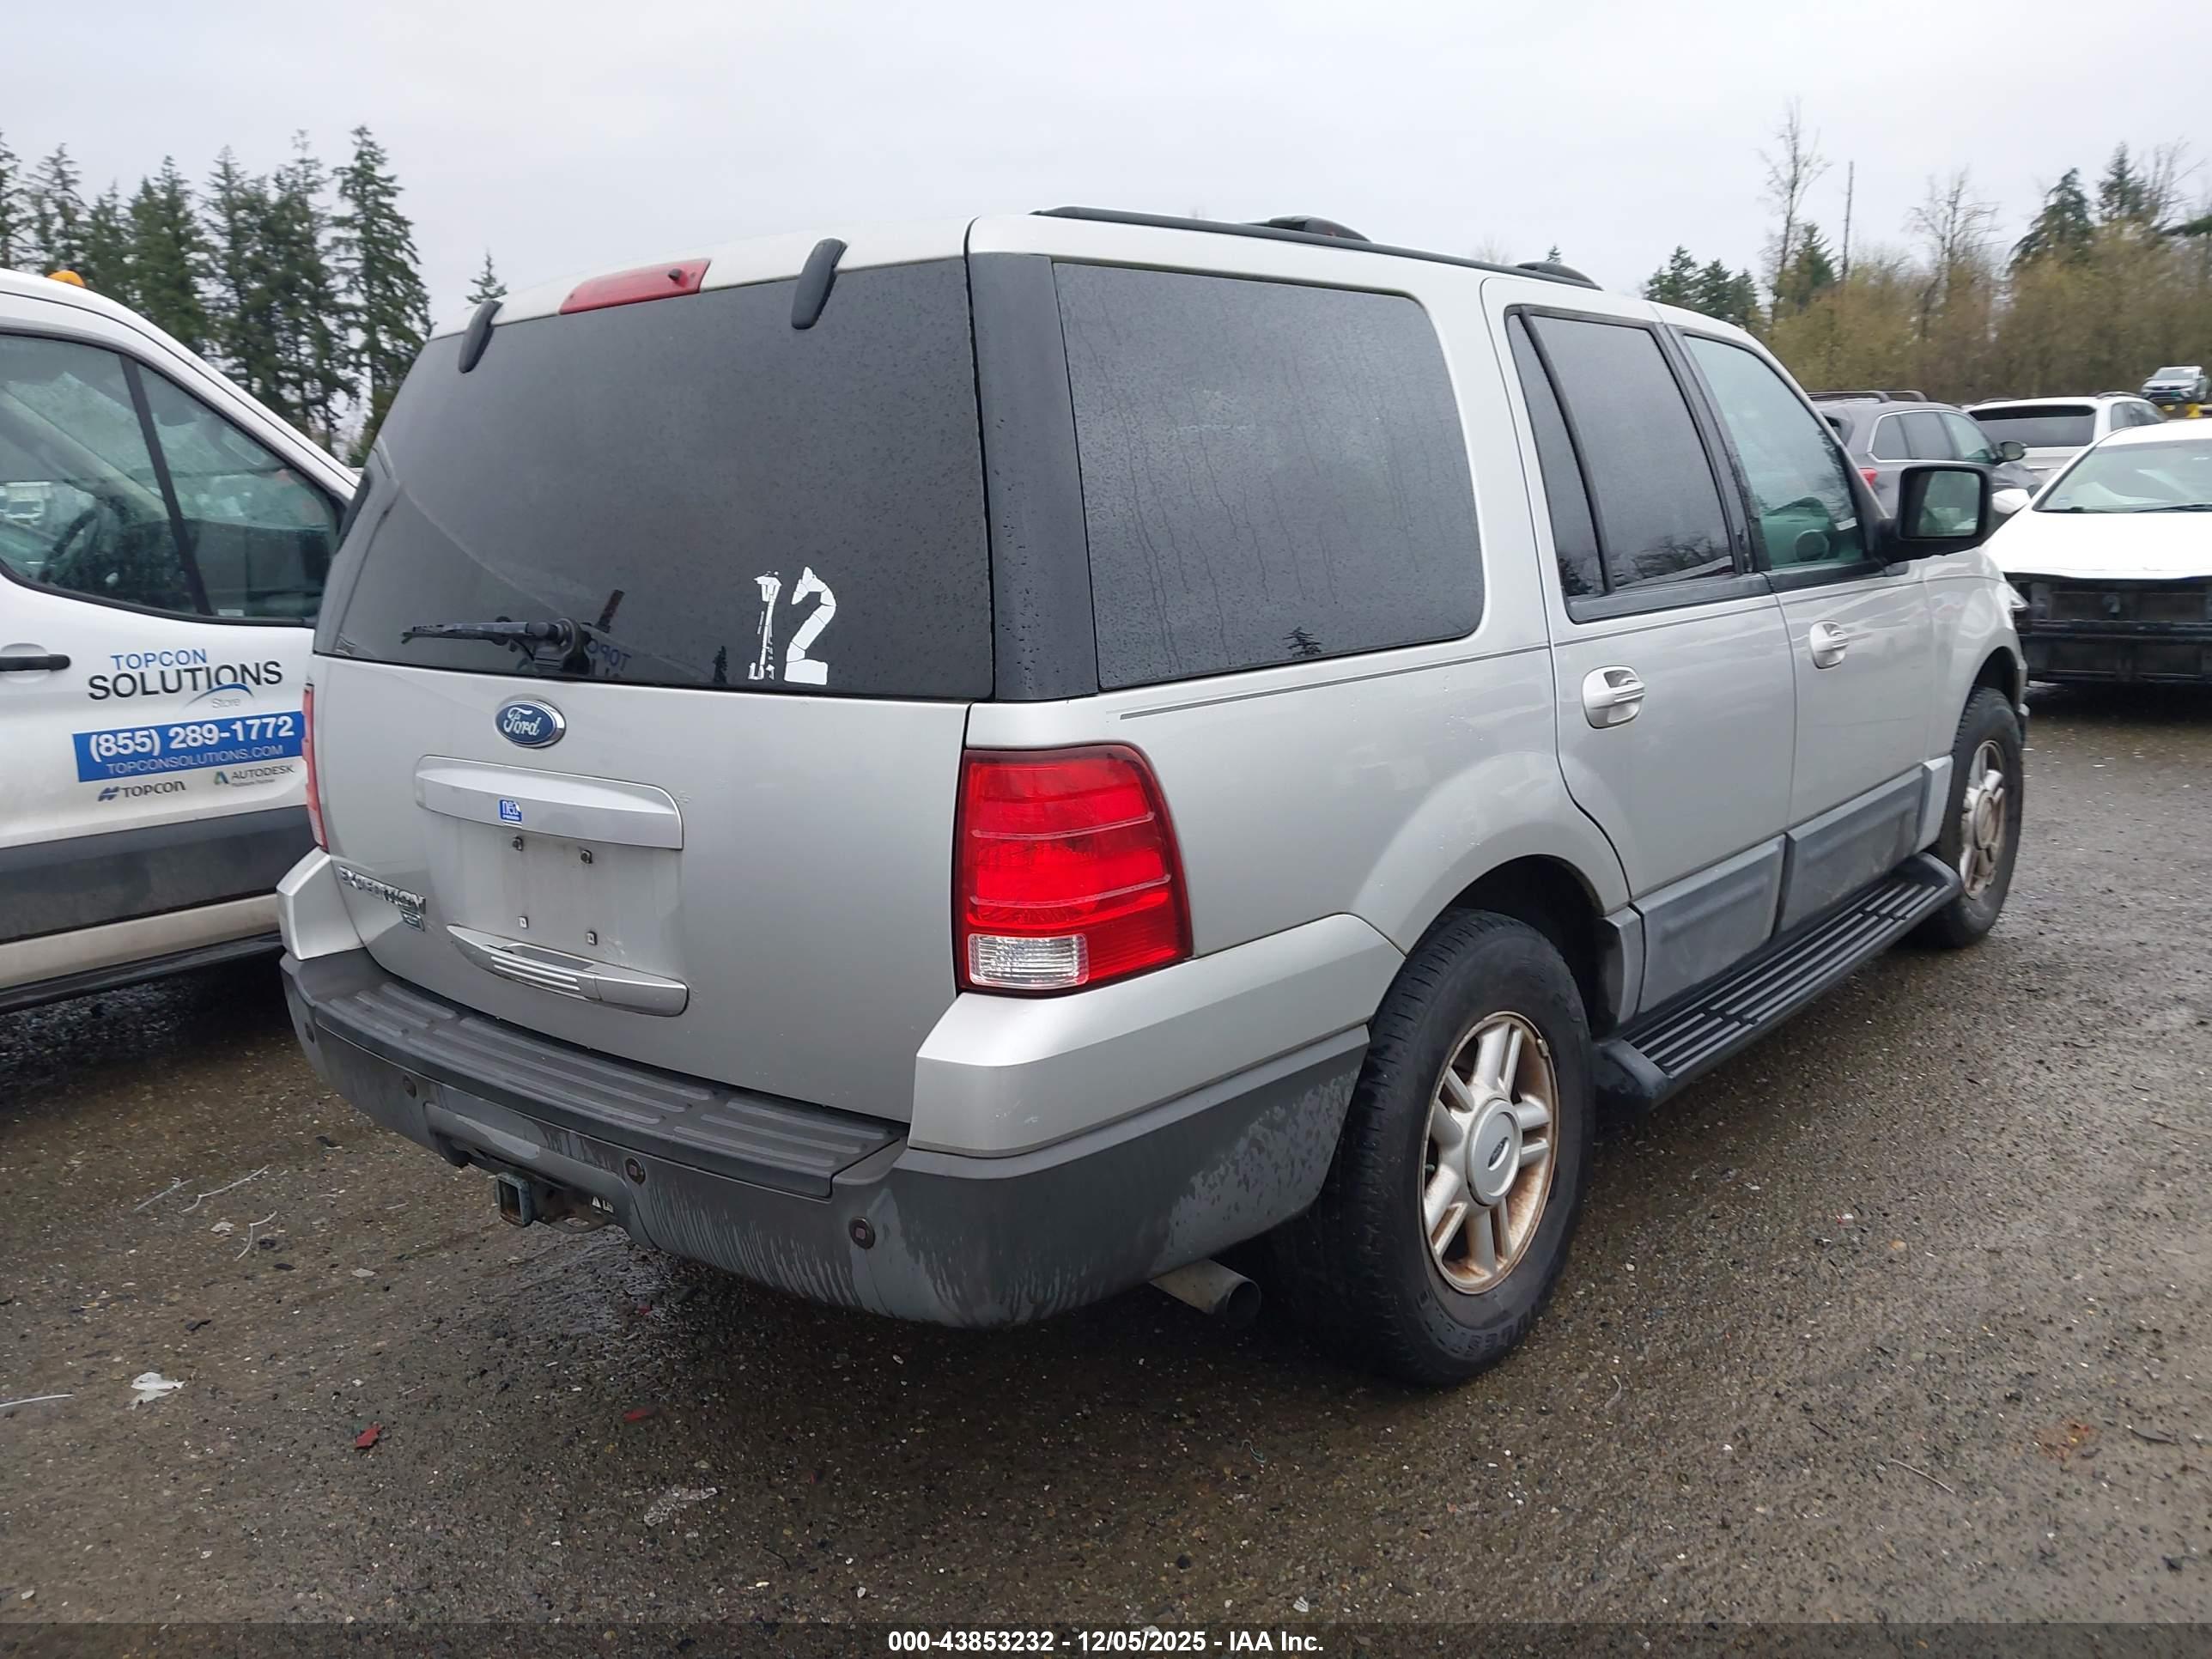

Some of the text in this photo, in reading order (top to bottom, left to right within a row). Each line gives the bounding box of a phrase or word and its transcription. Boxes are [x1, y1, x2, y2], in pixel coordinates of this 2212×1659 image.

[110, 648, 207, 671] TOPCON
[88, 661, 283, 700] SOLUTIONS
[212, 696, 241, 709] Store
[503, 707, 542, 736] Ford
[89, 716, 295, 763] (855) 289-1772
[106, 745, 283, 775] TOPCONSOLUTIONS.COM
[231, 765, 295, 781] AUTODESK
